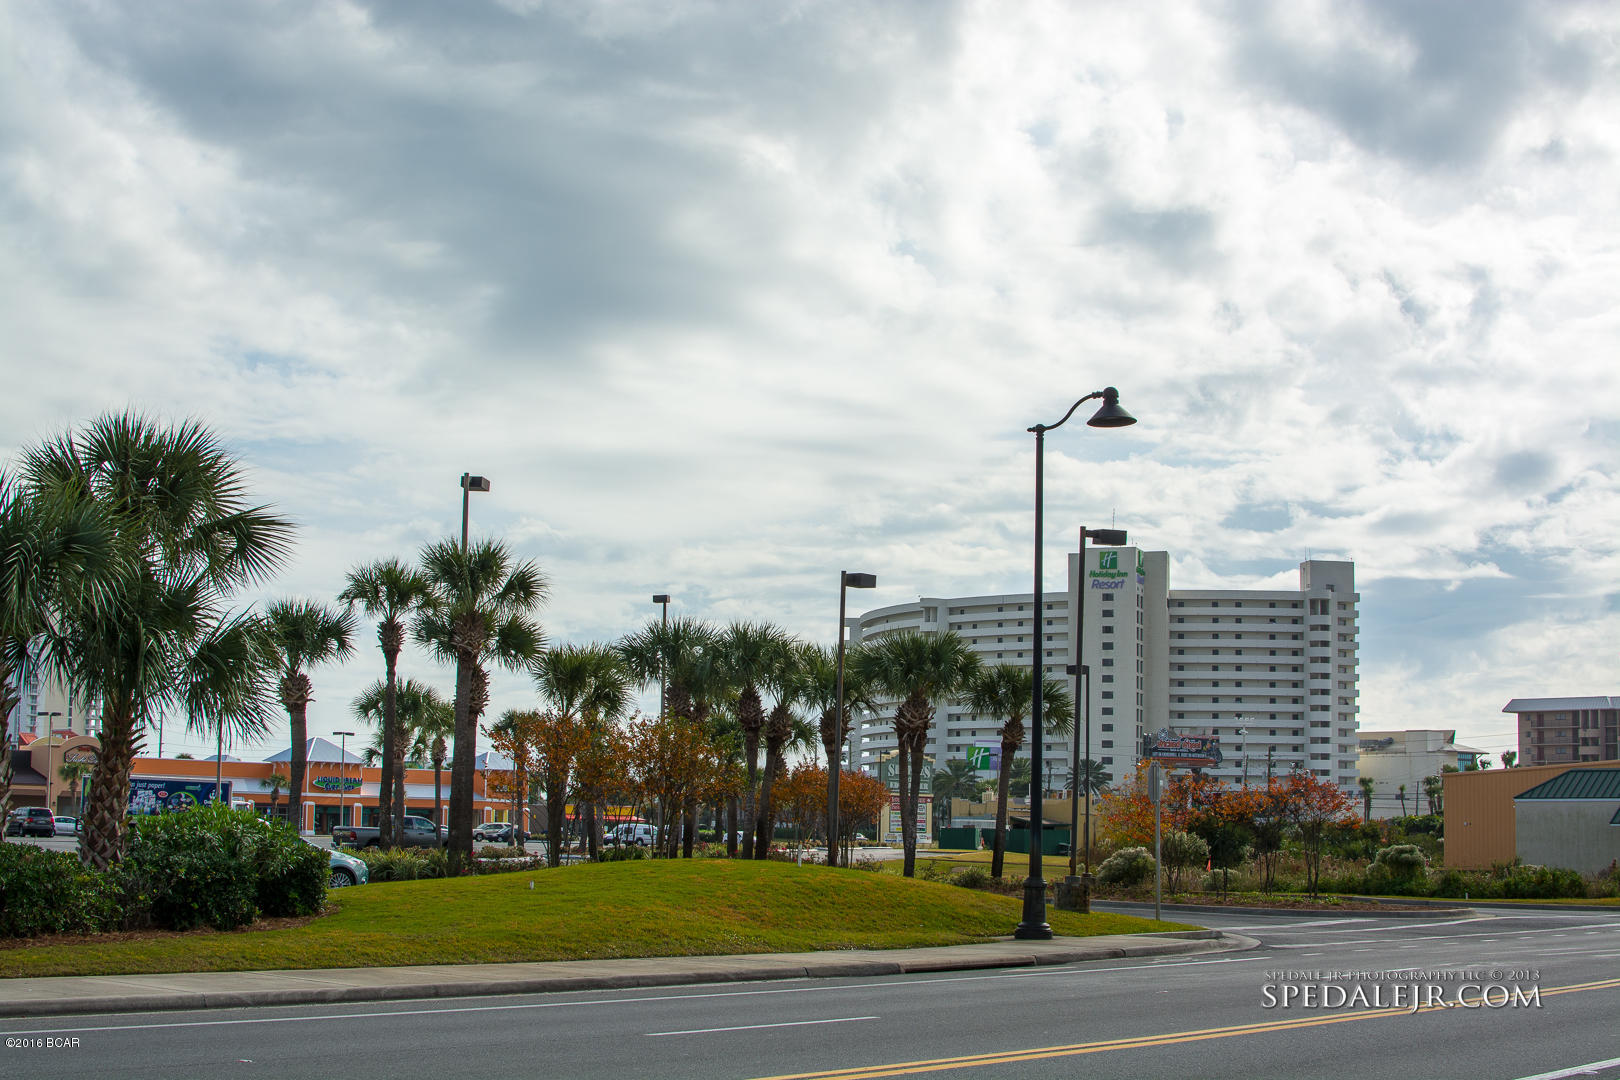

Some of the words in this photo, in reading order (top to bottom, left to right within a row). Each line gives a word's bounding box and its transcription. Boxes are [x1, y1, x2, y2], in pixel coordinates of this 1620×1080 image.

[1089, 569, 1117, 579] Holiday
[1117, 569, 1128, 577] Inn
[1091, 579, 1125, 589] Resort
[134, 782, 146, 790] just
